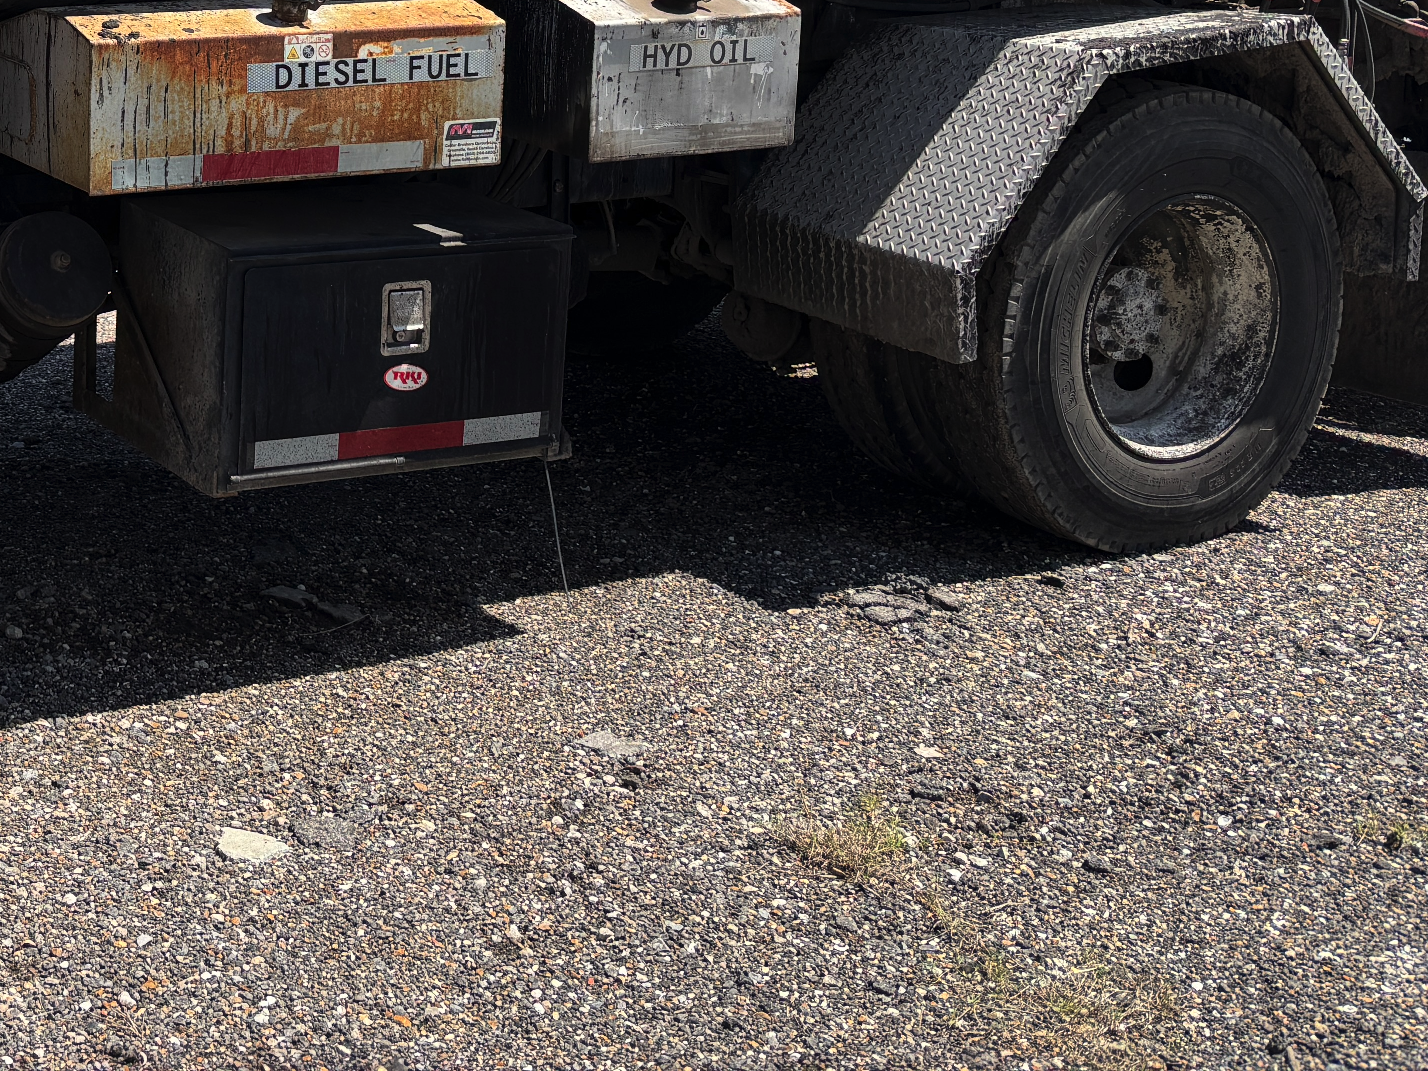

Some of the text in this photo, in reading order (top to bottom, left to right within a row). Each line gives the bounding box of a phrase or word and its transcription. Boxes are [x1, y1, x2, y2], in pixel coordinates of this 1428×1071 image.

[275, 52, 480, 90] DIESEL FUEL
[642, 39, 756, 69] HYD OIL
[1059, 252, 1089, 375] MICHELIN
